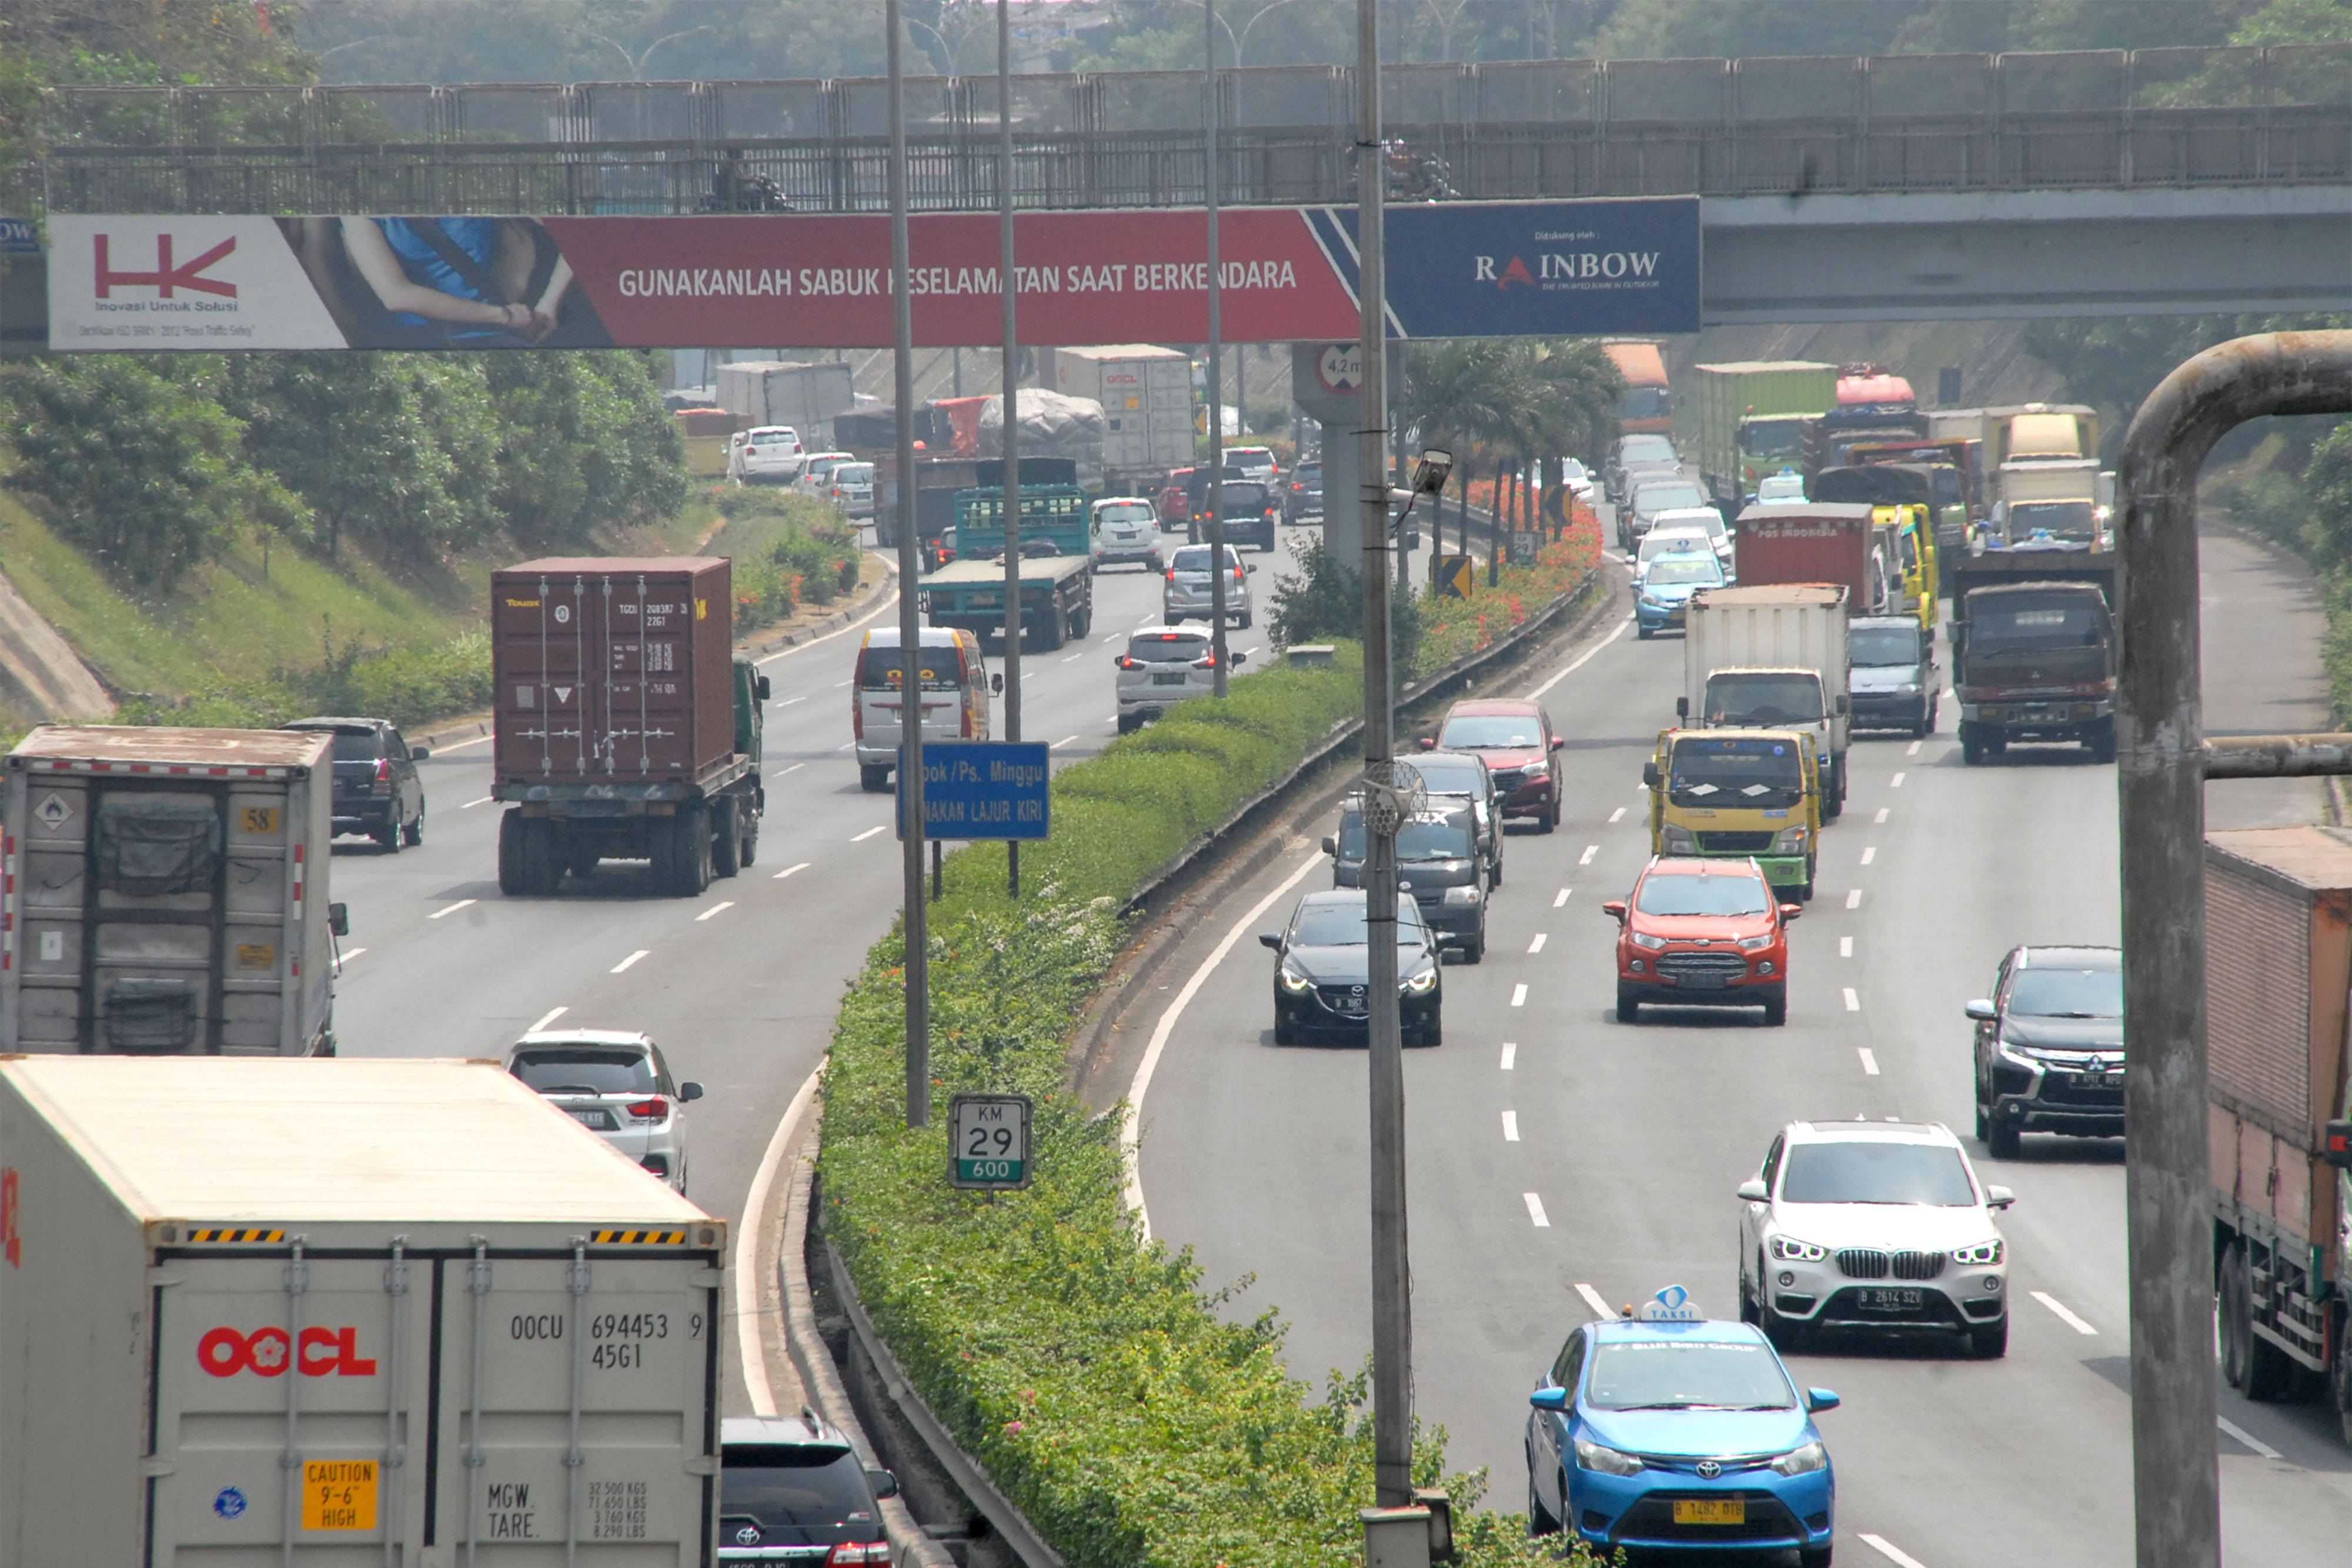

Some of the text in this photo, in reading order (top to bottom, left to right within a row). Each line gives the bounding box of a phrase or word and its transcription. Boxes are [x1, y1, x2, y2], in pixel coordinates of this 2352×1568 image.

[94, 234, 237, 298] HK
[619, 269, 791, 296] GUNAKANLAH
[799, 268, 880, 295] SABUK
[1067, 264, 1127, 292] SAAT
[95, 300, 238, 312] Inovasi Untuk Solusi
[991, 761, 1043, 787] Minggu
[248, 808, 269, 831] 58
[971, 801, 1011, 822] LAJUR
[1018, 800, 1043, 821] KIRI
[978, 1106, 1003, 1122] KM
[968, 1127, 1013, 1156] 29
[973, 1161, 1009, 1176] 600
[592, 1313, 669, 1339] 694453
[690, 1314, 703, 1339] 9
[1651, 1310, 1693, 1319] TAKSI
[198, 1326, 377, 1378] OOCL
[592, 1343, 641, 1369] 45G1
[308, 1463, 372, 1483] CAUTION
[487, 1481, 647, 1509] MGW. 32.500 KGS
[626, 1496, 646, 1509] LBS
[322, 1508, 356, 1527] HIGH
[488, 1512, 539, 1539] TARE.
[627, 1510, 646, 1523] KGS
[626, 1525, 646, 1538] LBS
